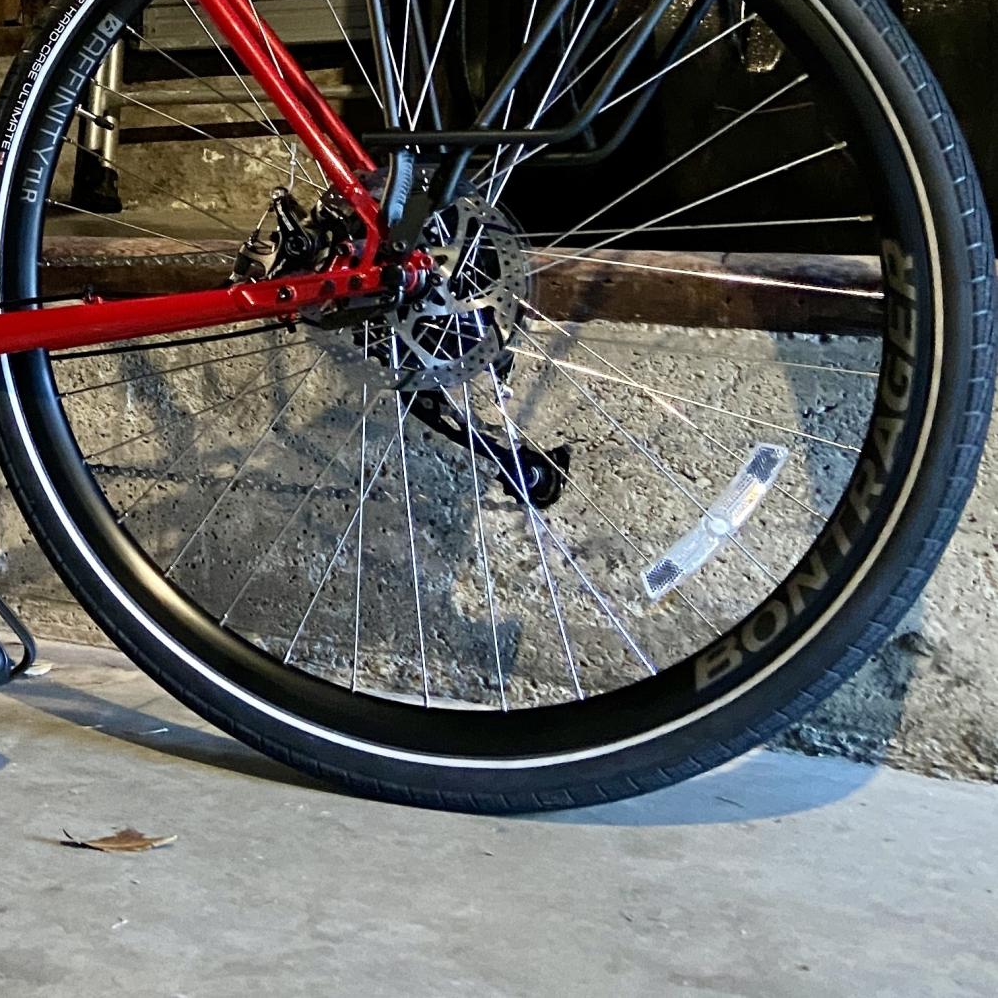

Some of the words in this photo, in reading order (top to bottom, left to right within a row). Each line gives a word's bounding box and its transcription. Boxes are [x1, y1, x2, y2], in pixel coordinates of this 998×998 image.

[27, 5, 78, 79] HARD-CASE
[1, 82, 33, 151] ULTIMATE
[32, 32, 107, 166] AFFINITY
[20, 166, 44, 203] TLR
[694, 238, 918, 692] BONTRAGER
